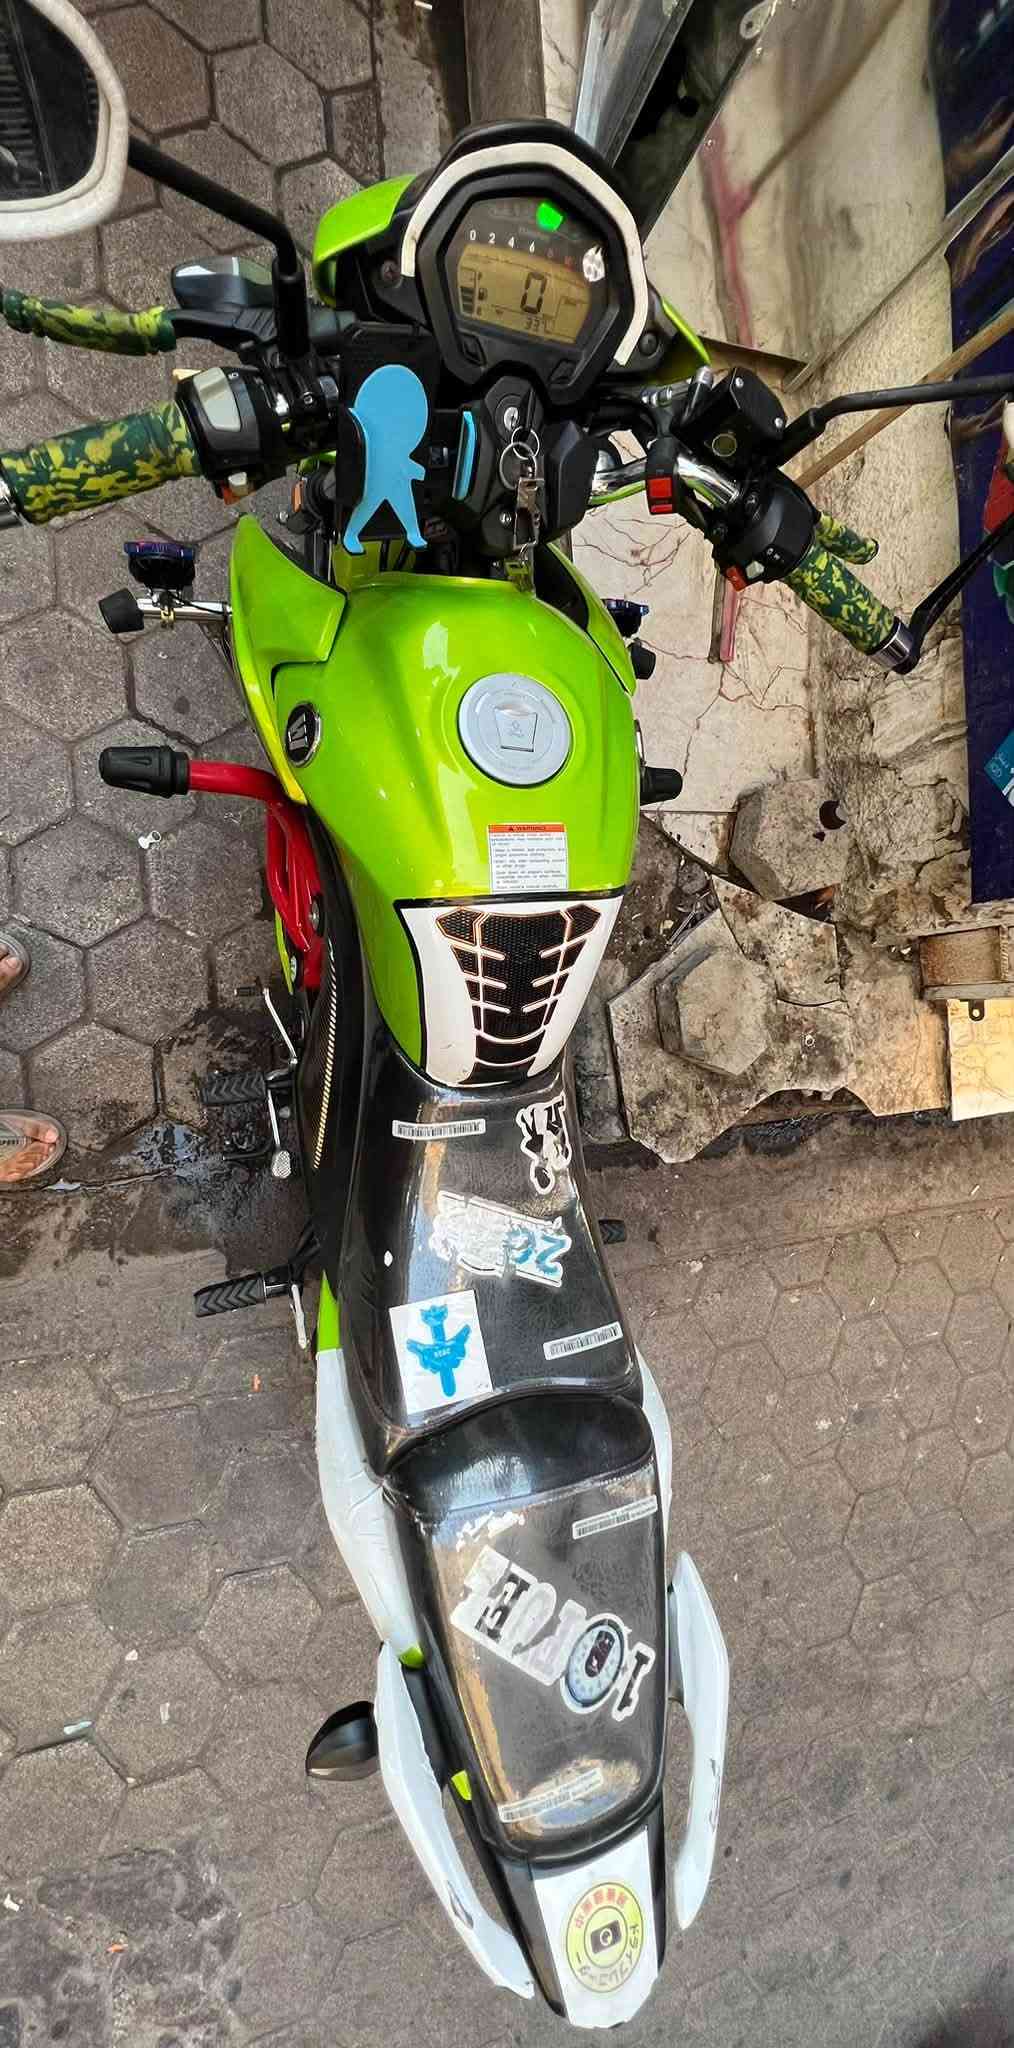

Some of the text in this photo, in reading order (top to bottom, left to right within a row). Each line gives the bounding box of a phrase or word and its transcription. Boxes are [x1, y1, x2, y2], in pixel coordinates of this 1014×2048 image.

[469, 229, 535, 253] 0 2 4 6
[520, 271, 546, 315] 0
